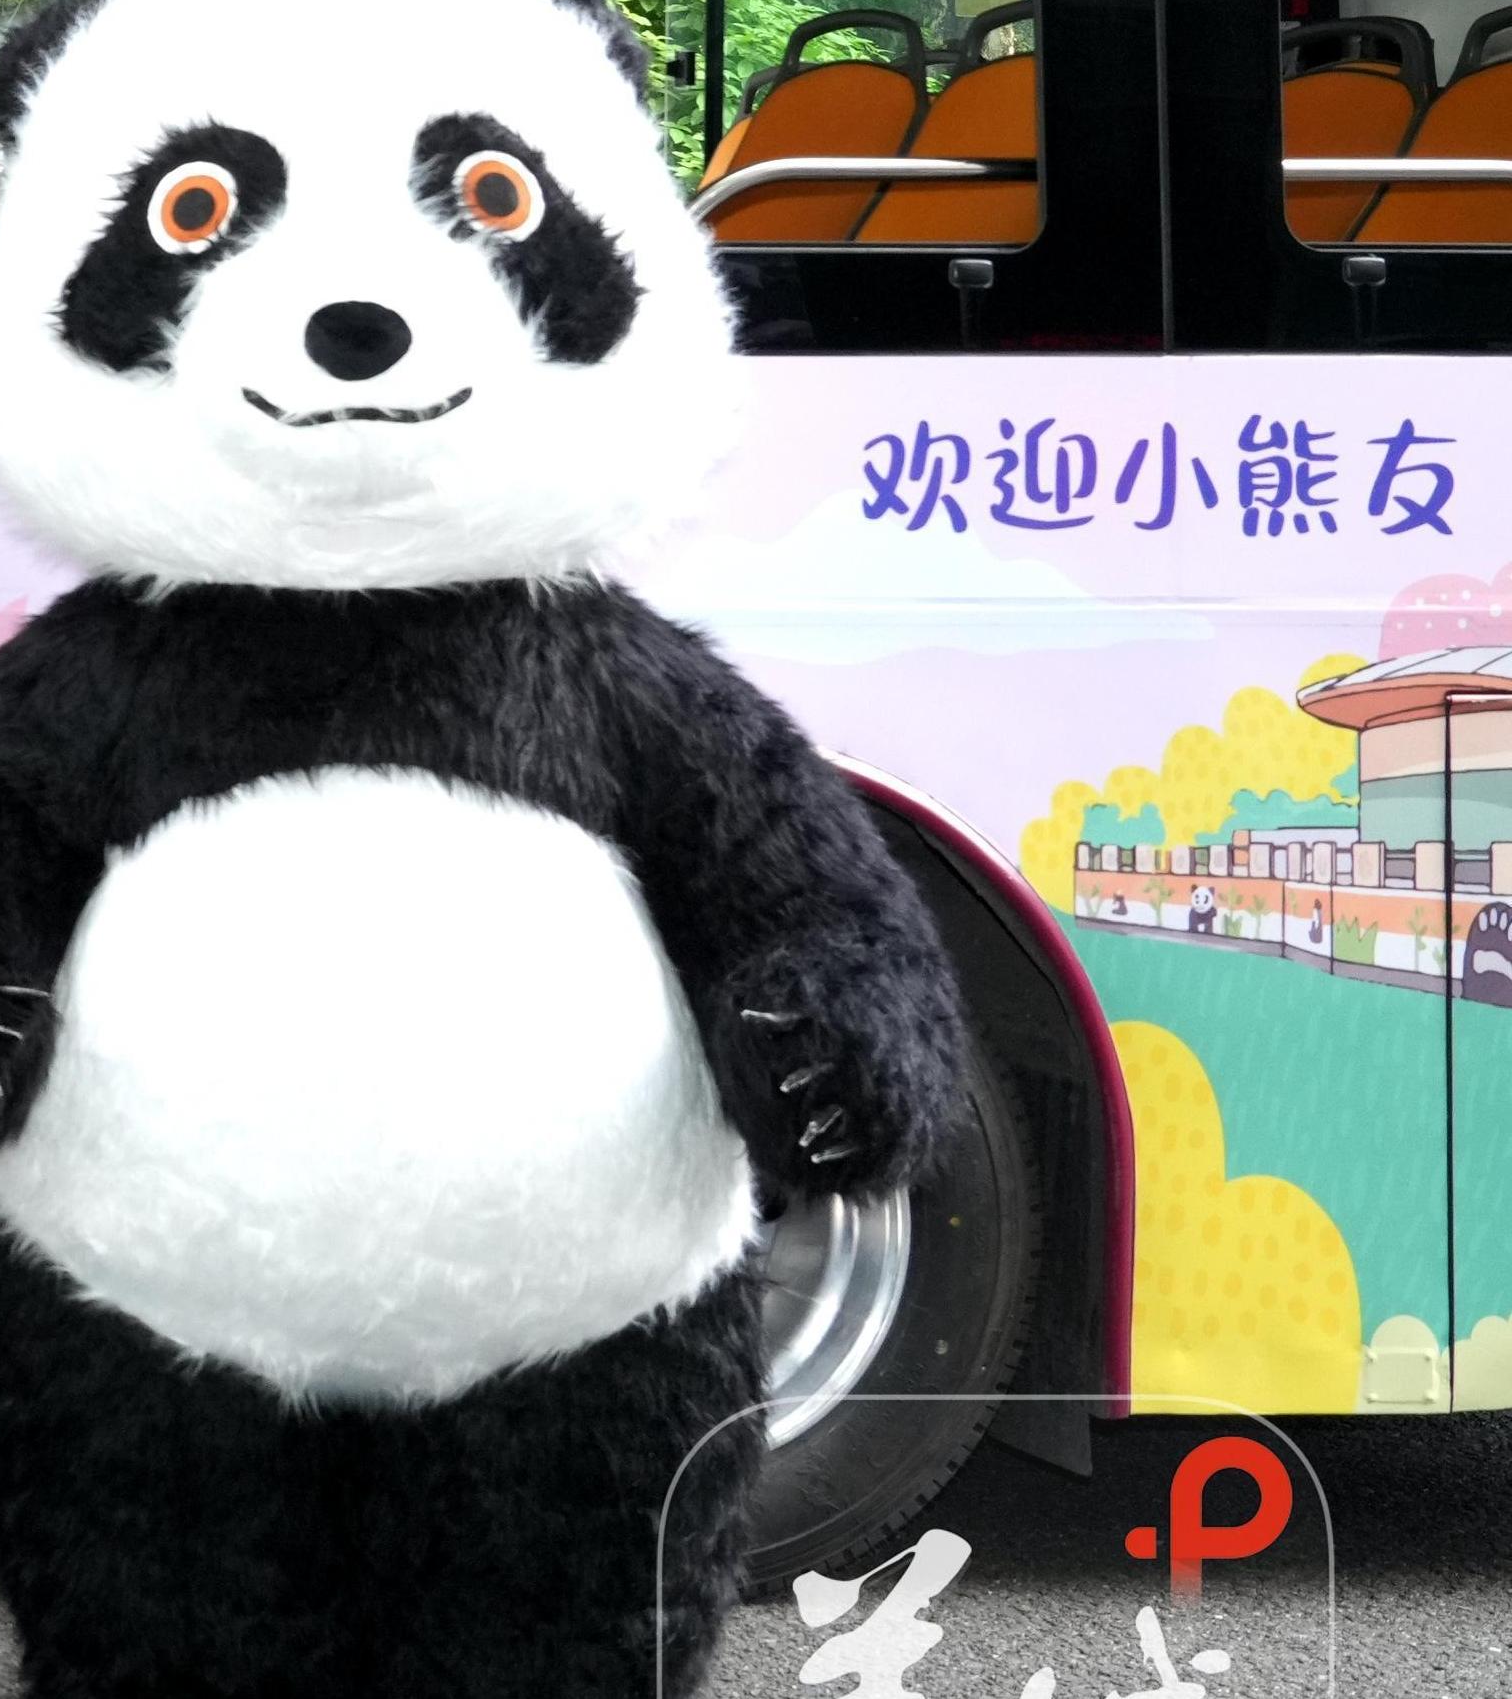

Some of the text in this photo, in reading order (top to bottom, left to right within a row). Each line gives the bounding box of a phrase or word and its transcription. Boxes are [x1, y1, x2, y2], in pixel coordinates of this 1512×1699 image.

[861, 414, 1457, 537] 欢迎小熊友
